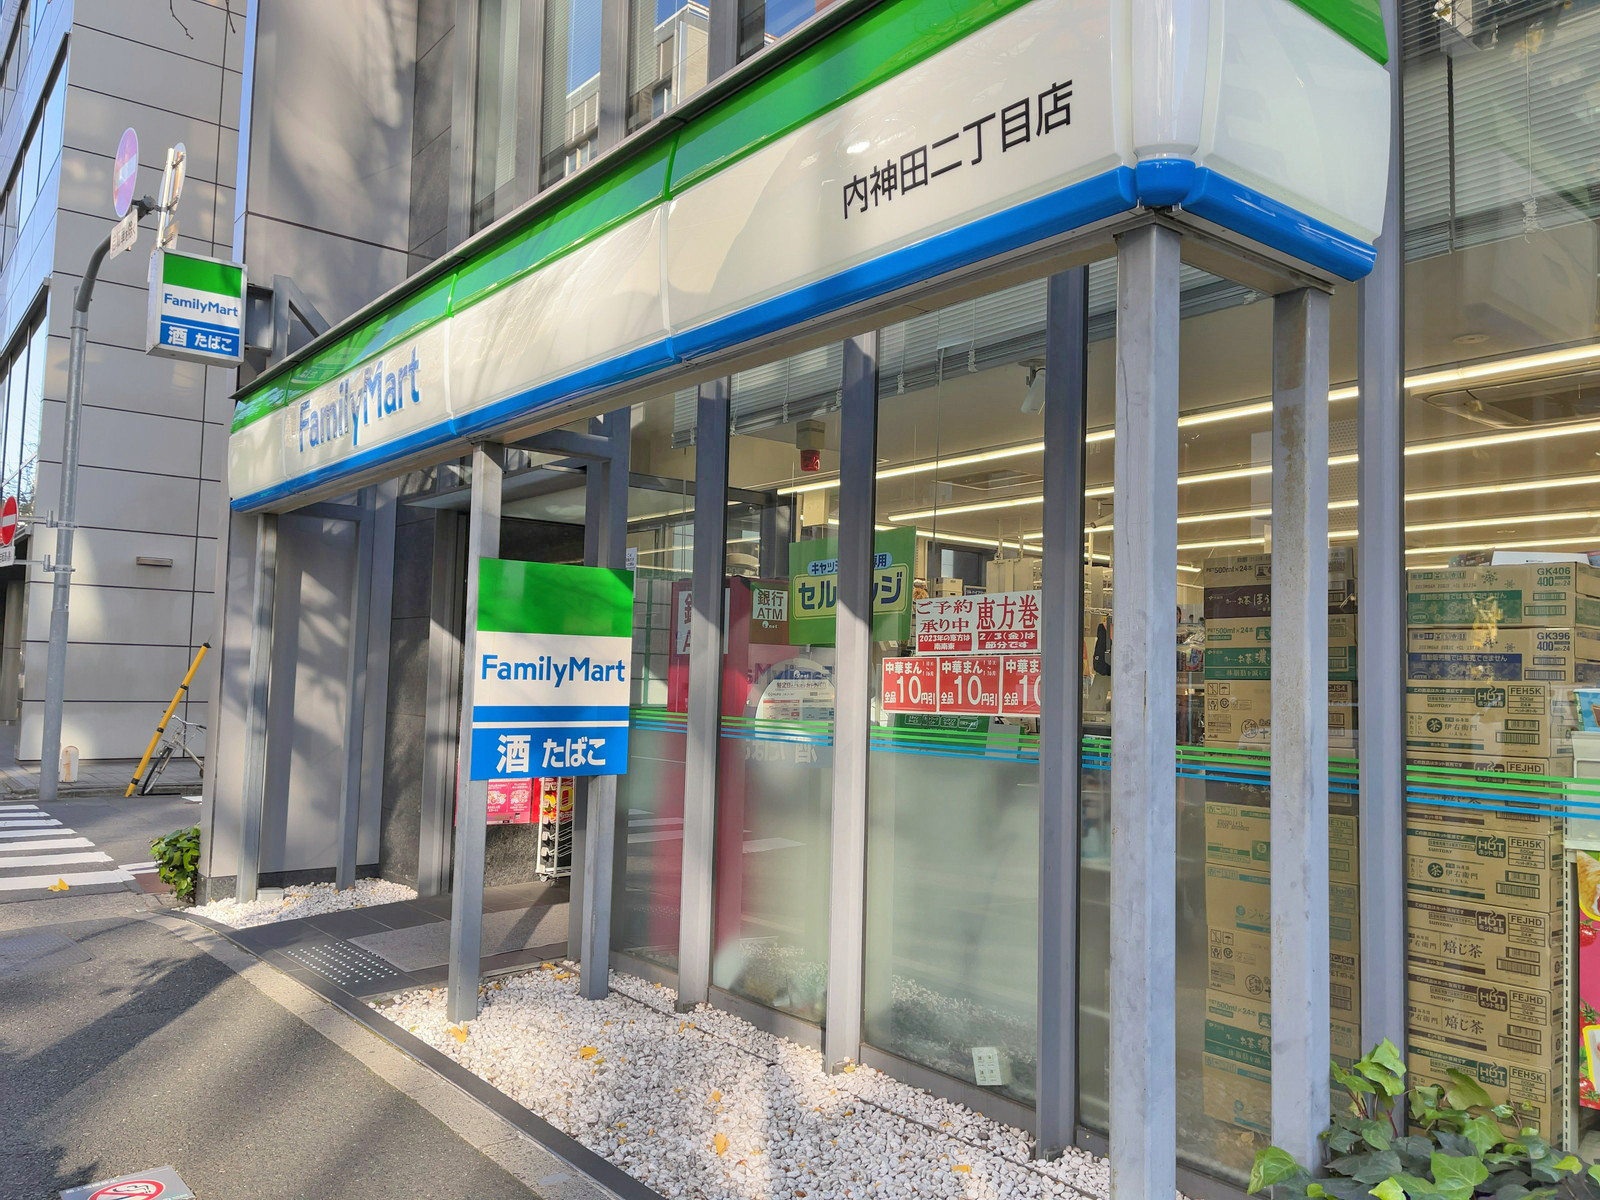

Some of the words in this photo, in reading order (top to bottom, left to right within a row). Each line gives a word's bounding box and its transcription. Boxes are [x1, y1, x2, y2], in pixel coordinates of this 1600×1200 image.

[843, 79, 1073, 220] 内神田二丁目店
[164, 292, 238, 317] FamilyMart
[168, 325, 188, 347] 酒
[194, 332, 232, 352] たばこ
[299, 344, 420, 452] FamilyMart
[1536, 566, 1571, 576] GK406
[757, 590, 784, 606] 銀行
[757, 607, 783, 620] ATM
[916, 599, 973, 615] ご予約
[976, 594, 1040, 630] 恵方巻
[920, 618, 970, 633] 承り中
[1536, 632, 1570, 640] GK396
[482, 654, 626, 688] FamilyMart
[886, 661, 922, 674] 中華まん
[942, 660, 982, 674] 中華まん
[1006, 659, 1041, 674] 中華ま
[1478, 692, 1504, 701] HOT
[496, 734, 532, 774] 酒
[542, 736, 606, 769] たばこ
[1510, 764, 1542, 772] FEJHD
[1478, 840, 1504, 852] HOT
[1511, 838, 1542, 848] FEH5K
[1478, 915, 1504, 928] HOT
[1511, 915, 1542, 926] FEJHD
[1443, 940, 1482, 959] 焙じ茶
[1480, 991, 1506, 1005] HOT
[1512, 992, 1543, 1005] FEJHD
[1444, 1014, 1484, 1035] 焙じ茶
[1480, 1067, 1506, 1081] HOT
[1512, 1068, 1543, 1082] FEH5K
